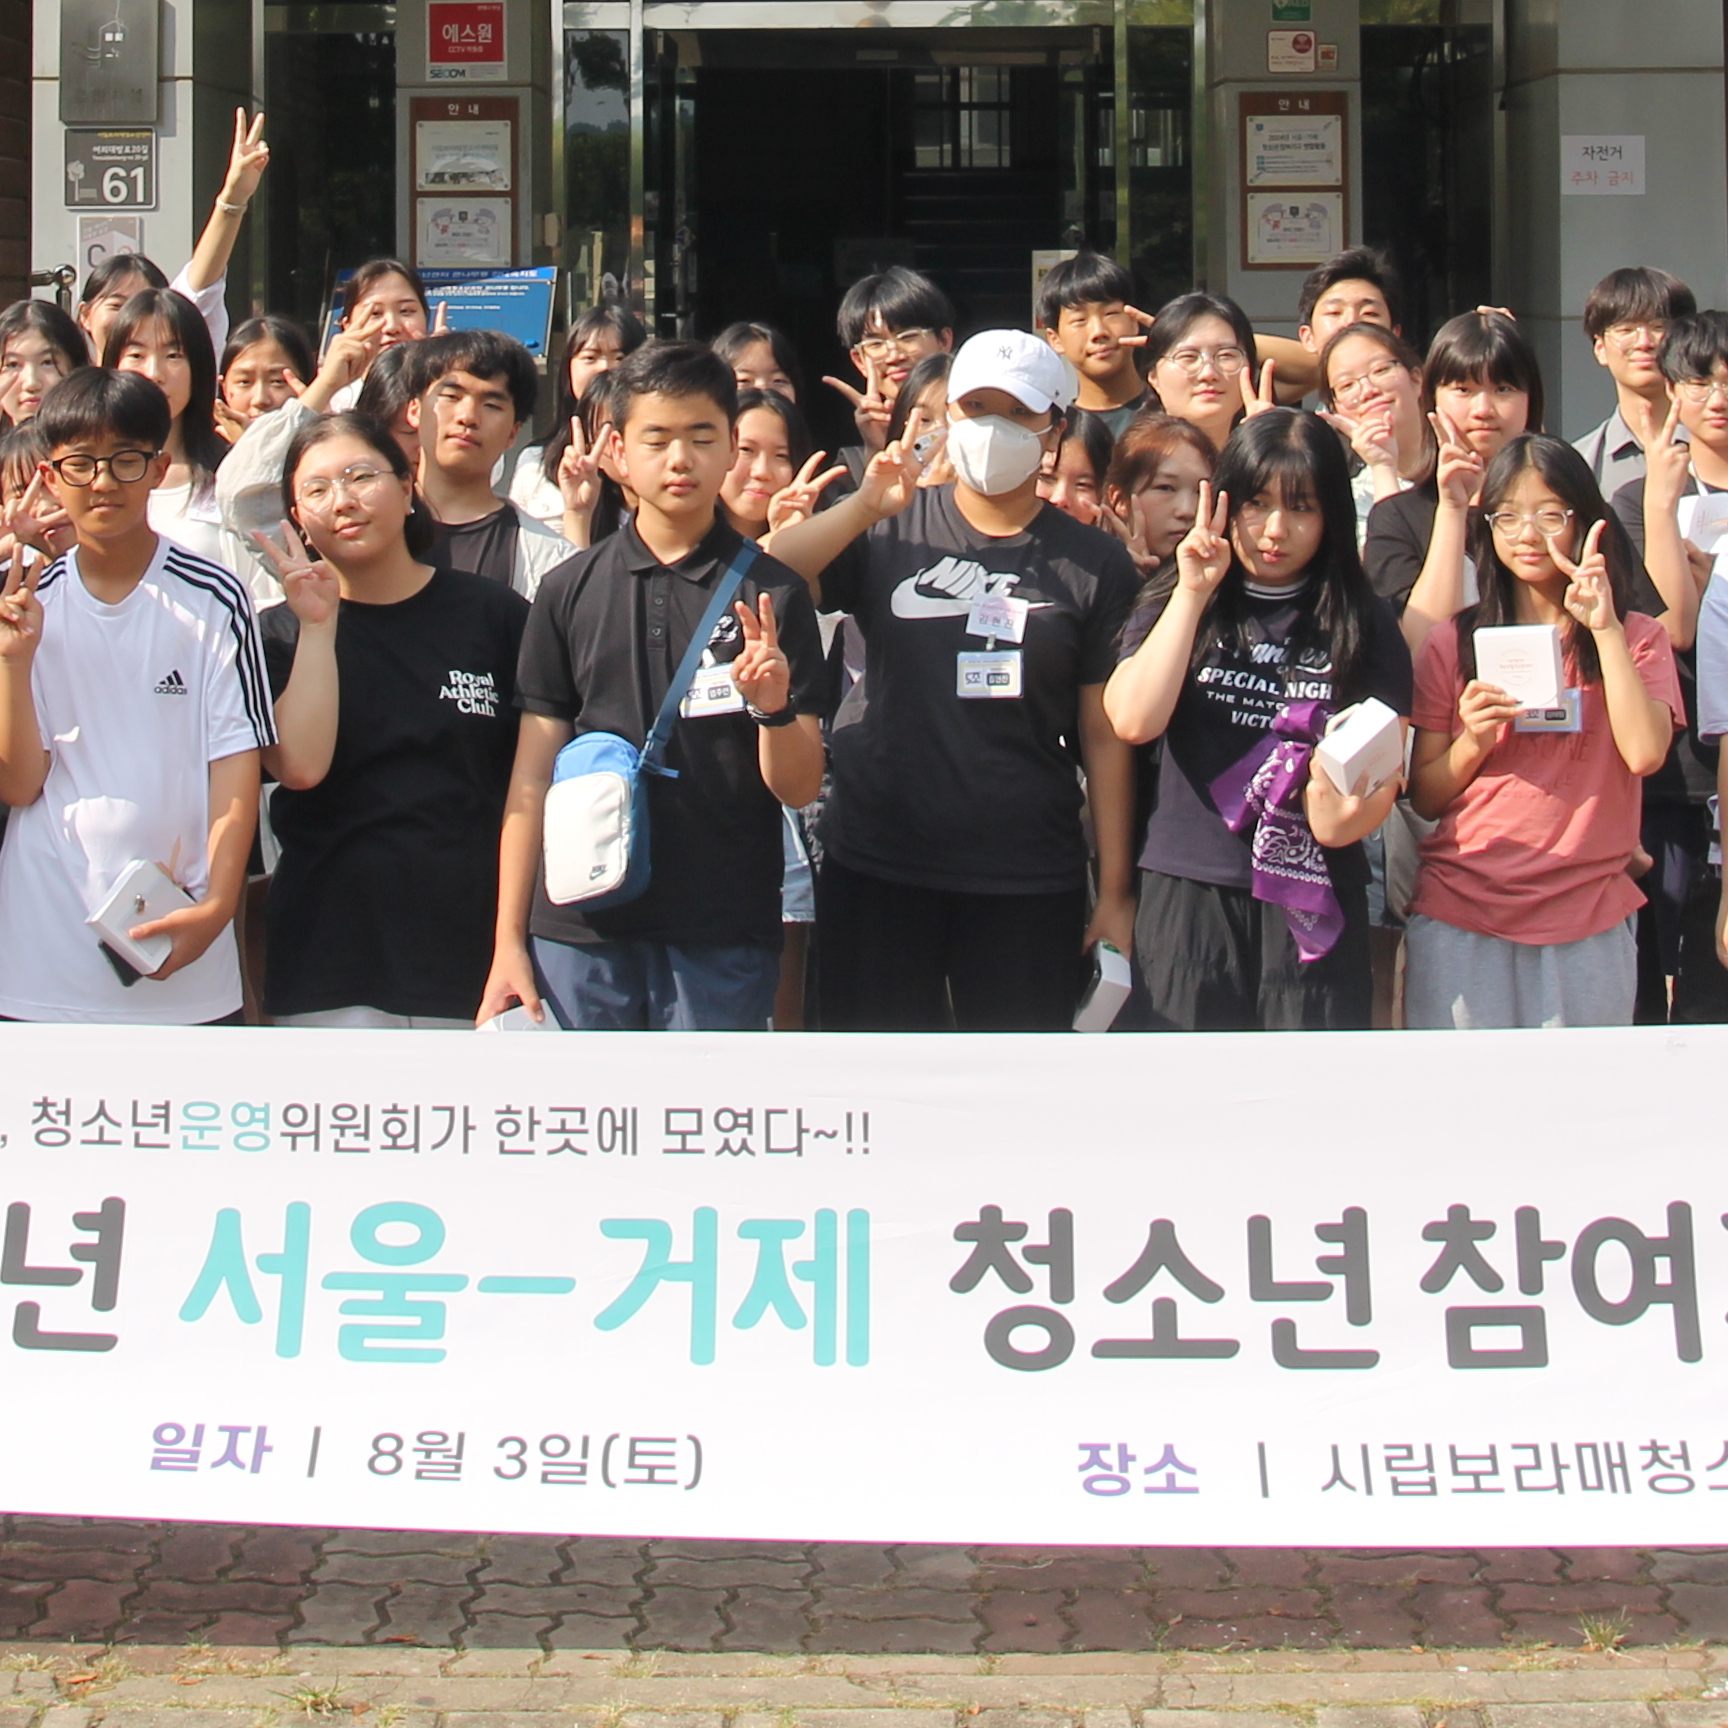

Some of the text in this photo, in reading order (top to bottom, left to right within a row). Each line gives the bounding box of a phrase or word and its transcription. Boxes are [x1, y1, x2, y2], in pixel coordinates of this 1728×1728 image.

[442, 23, 492, 43] 에스원
[1581, 144, 1622, 161] 자전거
[102, 165, 145, 203] 61
[1571, 170, 1634, 187] 주차 금지
[917, 556, 1021, 600] NIKE
[448, 669, 495, 688] Royal
[1197, 666, 1333, 701] SPECIAL NIGH
[154, 686, 188, 695] adidas
[438, 684, 499, 704] Athletic
[1206, 690, 1237, 705] THE
[456, 697, 496, 718] Club
[30, 1094, 478, 1157] 청소년운영위원회가
[493, 1105, 641, 1158] 한곳에
[662, 1106, 872, 1160] 모였다~!!
[179, 1201, 872, 1371] 서울-거제
[948, 1203, 1383, 1375] 청소년
[151, 1422, 705, 1493] 일자 8월 3일(토)
[1078, 1441, 1200, 1499] 장소
